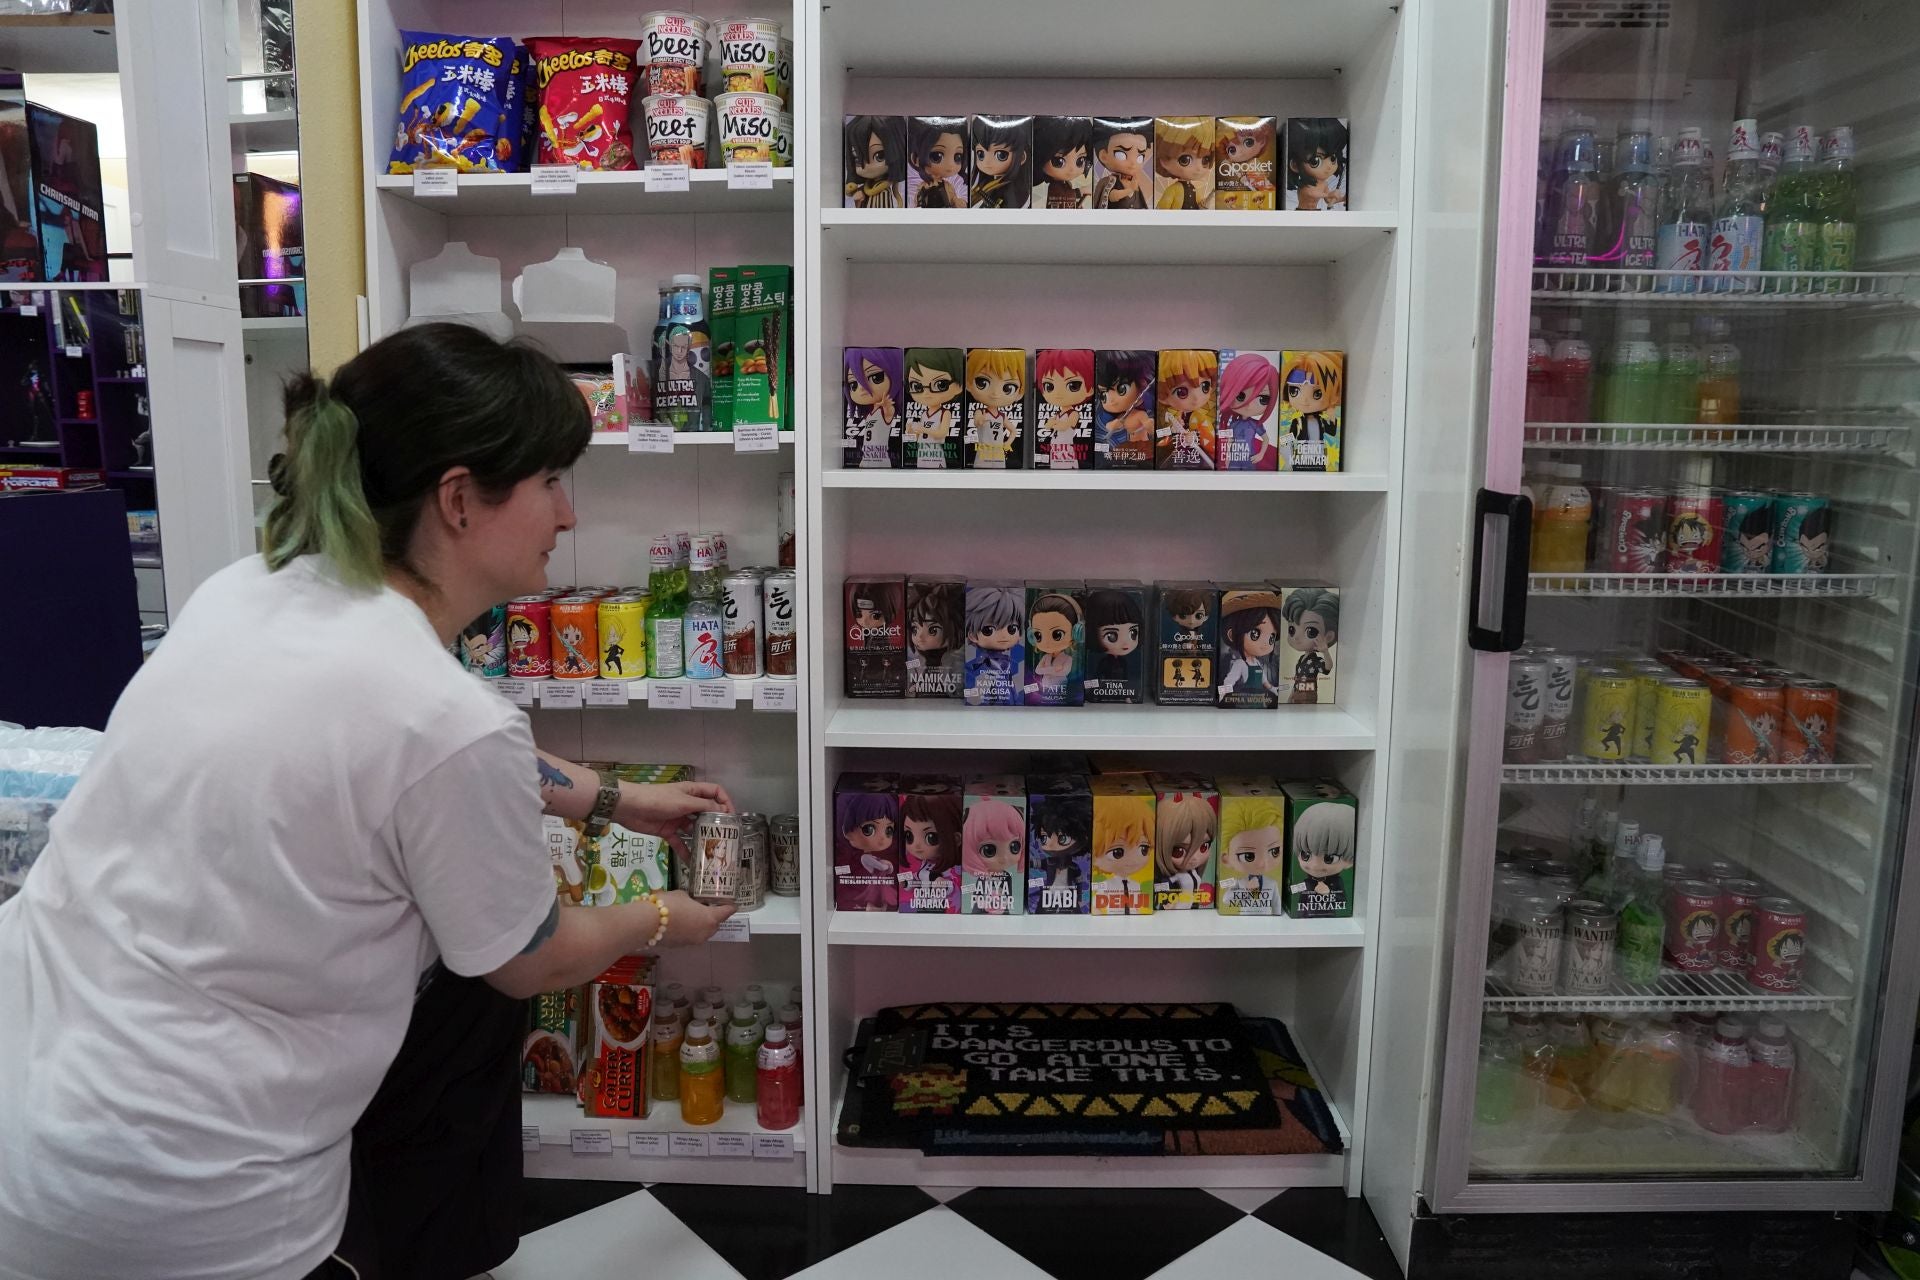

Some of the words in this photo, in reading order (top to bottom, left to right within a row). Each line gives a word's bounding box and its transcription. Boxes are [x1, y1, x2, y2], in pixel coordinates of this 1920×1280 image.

[665, 16, 685, 26] CUP
[728, 24, 747, 33] CUP
[648, 31, 700, 60] Beef
[720, 40, 766, 65] Miso
[404, 40, 461, 73] Cheetos
[537, 50, 593, 89] Cheetos
[441, 64, 494, 92] 玉米棒
[580, 73, 628, 95] 玉米棒
[658, 99, 676, 108] CUP
[735, 98, 755, 107] CUP
[647, 115, 696, 139] Beef
[723, 113, 771, 139] Miso
[1219, 158, 1272, 178] Qposket
[40, 183, 81, 212] CHAINSAW
[82, 204, 99, 222] MAN
[712, 284, 736, 299] 땅콩
[740, 281, 764, 299] 땅콩
[740, 291, 785, 310] 초코스틱
[668, 380, 695, 392] ULTRA
[992, 430, 999, 440] 7
[1221, 443, 1250, 452] HYOMA
[1297, 443, 1325, 454] DENKI
[1220, 452, 1250, 461] CHIGIRI
[650, 546, 673, 556] HATA
[692, 620, 719, 631] HATA
[849, 622, 901, 641] Qposket
[910, 673, 962, 684] NAMIKAZE
[976, 680, 1014, 688] KAWORU
[915, 683, 957, 693] MINATO
[1093, 688, 1135, 696] GOLDSTEIN
[700, 826, 738, 840] WANTED
[611, 831, 628, 868] 大福
[913, 888, 947, 898] OCHACO
[976, 880, 1010, 895] ANYA
[970, 894, 1014, 910] FORGER
[1042, 889, 1078, 908] DABI
[1096, 893, 1150, 908] DENJI
[1233, 891, 1270, 900] KENTO
[1308, 893, 1336, 903] TOGE
[910, 898, 950, 909] URARAKA
[1229, 899, 1272, 908] NANAMI
[1297, 901, 1347, 912] INUMAKI
[934, 1024, 1030, 1037] IT'S
[932, 1037, 1178, 1053] DANGEROUS
[1188, 1038, 1232, 1051] TO
[963, 1052, 1018, 1065] GO
[1047, 1053, 1206, 1067] ALONE!
[602, 1051, 618, 1109] GOLDEN
[616, 1050, 633, 1112] CURRY
[985, 1067, 1094, 1083] TAKE
[1111, 1067, 1242, 1082] THIS.
